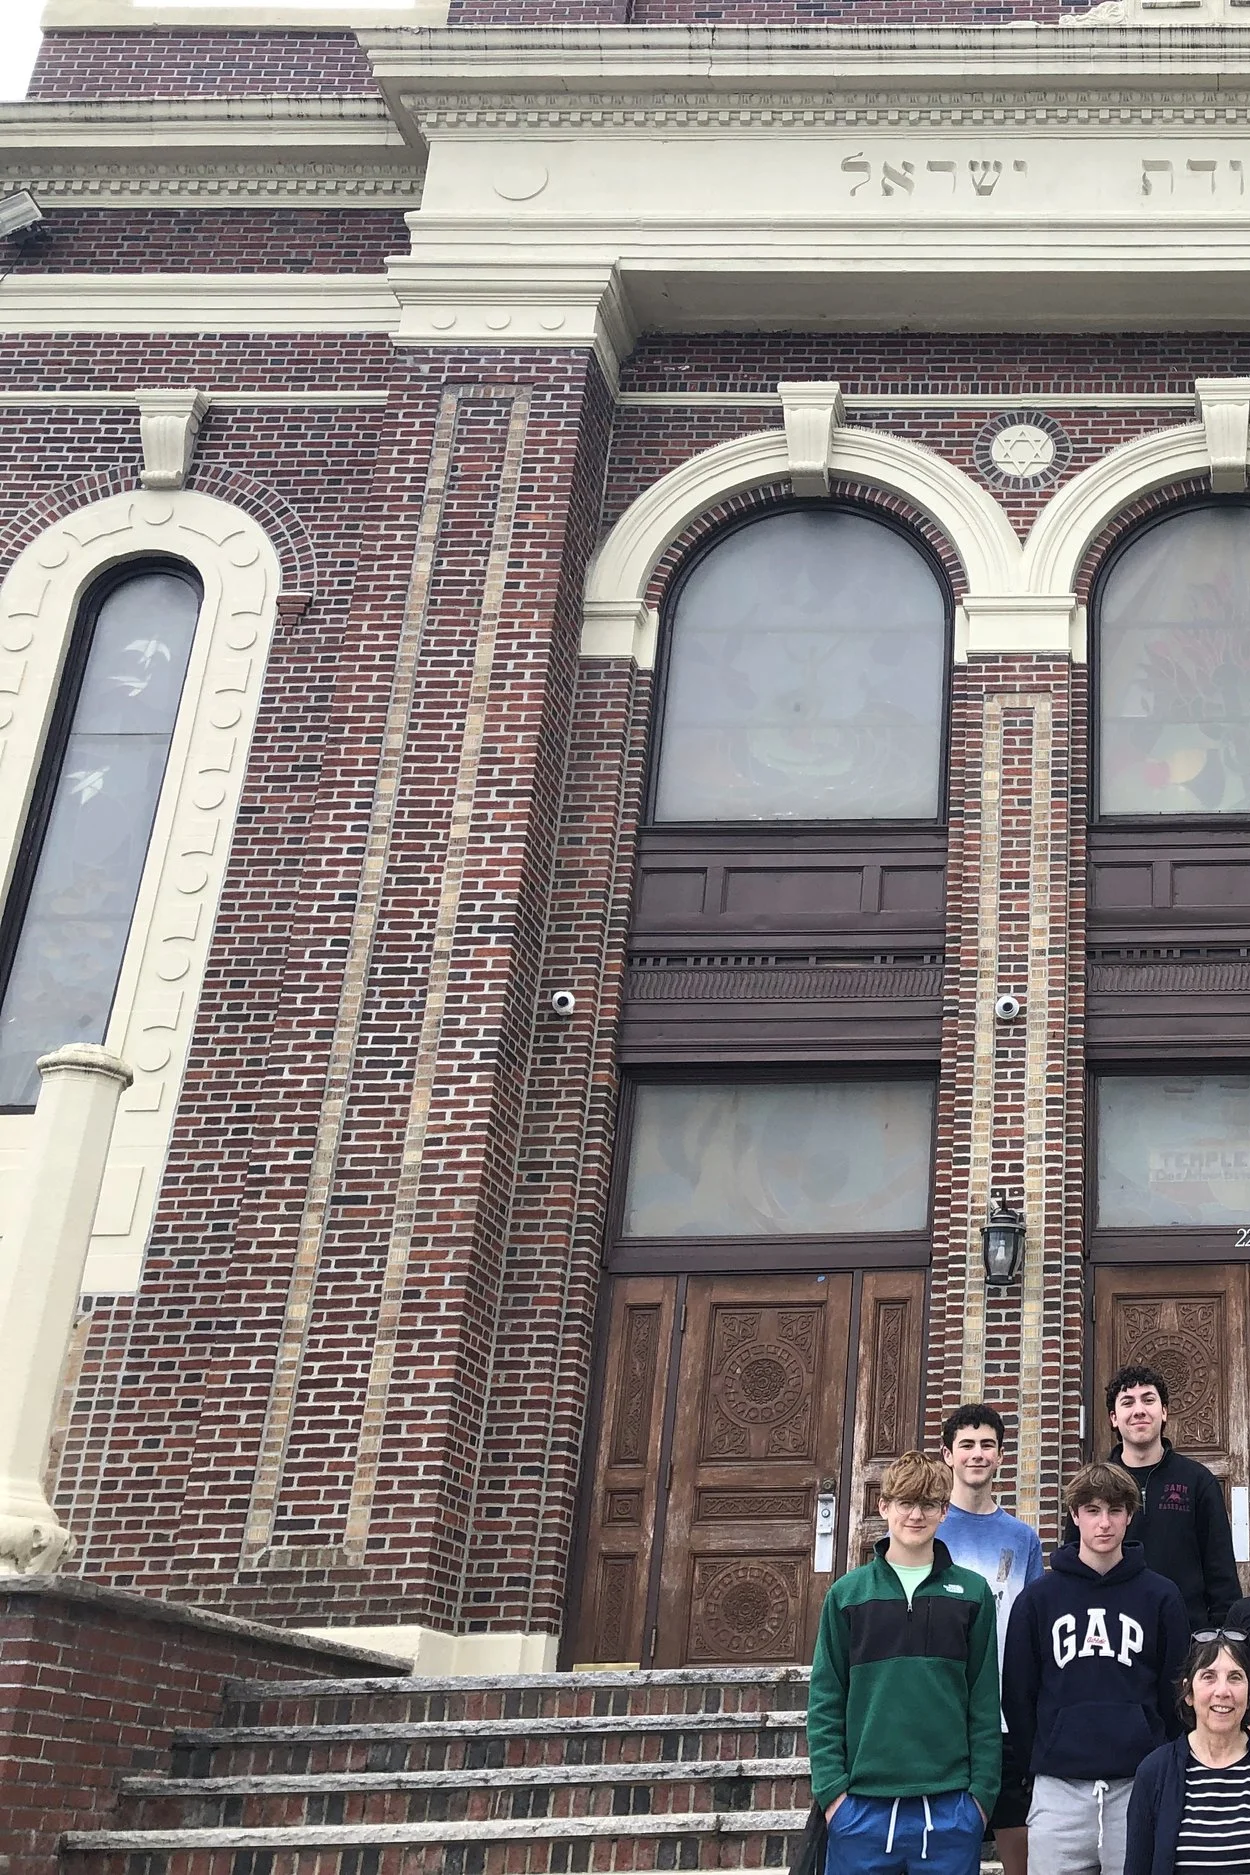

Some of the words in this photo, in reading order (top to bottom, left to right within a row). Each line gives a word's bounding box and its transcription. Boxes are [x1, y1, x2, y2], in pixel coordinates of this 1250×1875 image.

[840, 151, 1028, 197] ישראל
[1160, 1150, 1248, 1168] TEMPLE
[1051, 1608, 1144, 1669] GAP
